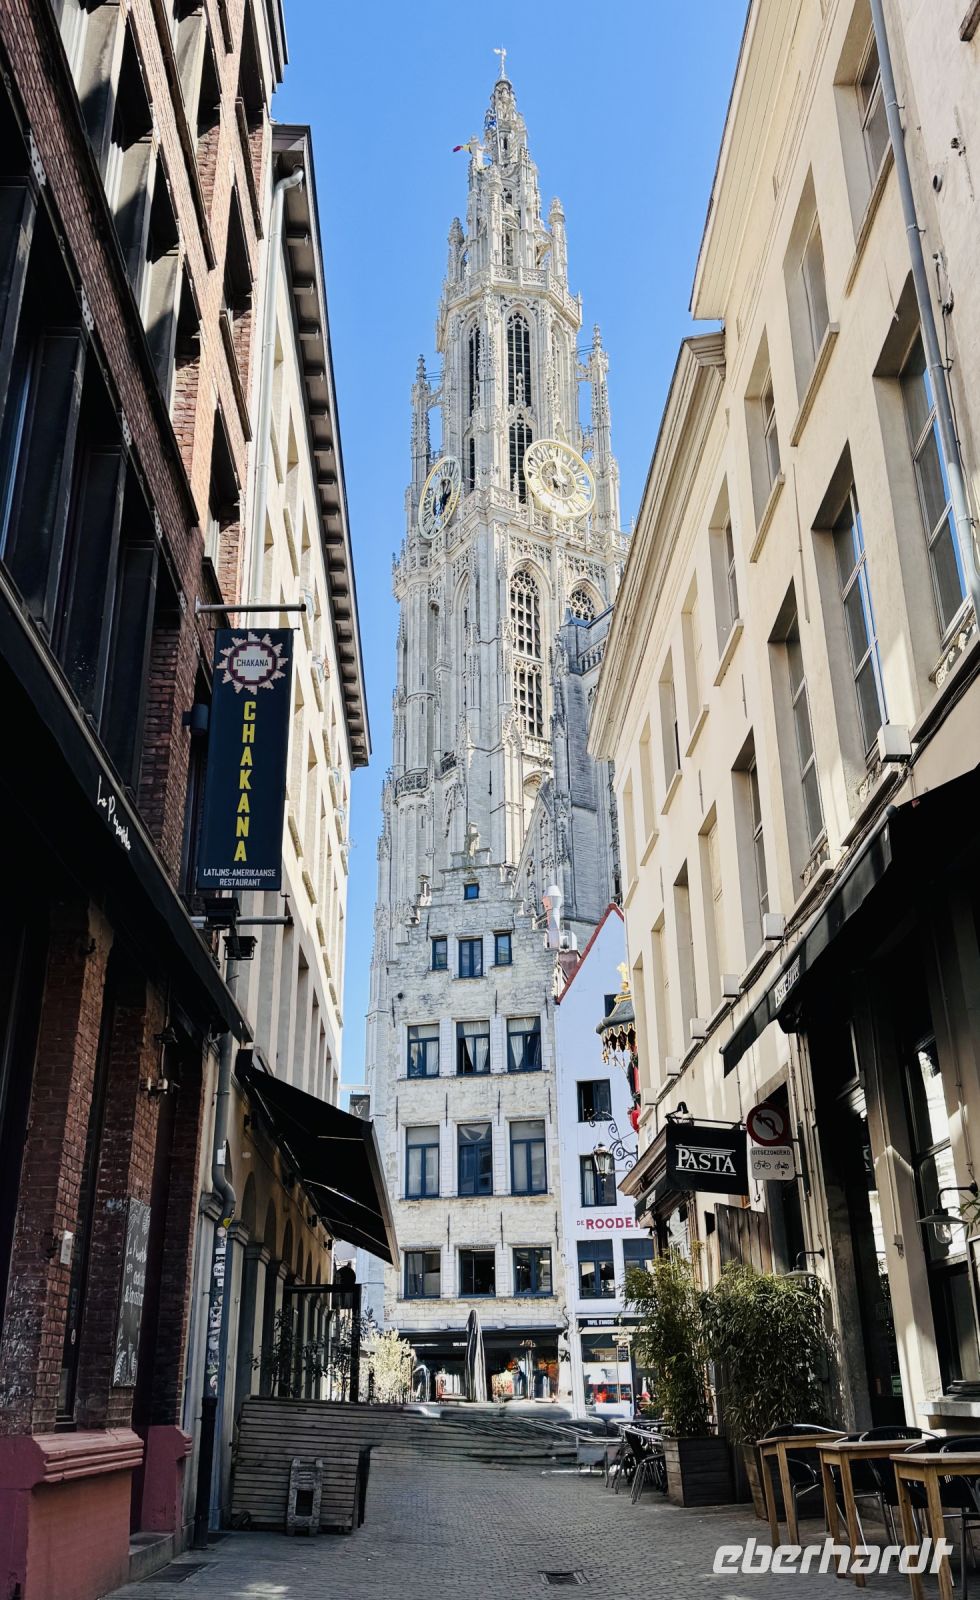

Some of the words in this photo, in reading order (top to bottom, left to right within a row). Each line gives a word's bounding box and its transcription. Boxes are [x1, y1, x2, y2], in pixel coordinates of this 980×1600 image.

[236, 658, 269, 668] CHAKANA
[234, 701, 257, 862] CHAKANA
[203, 868, 276, 877] LATIJNS-AMERIKAANSE
[219, 877, 261, 887] RESTAURANT
[675, 1148, 736, 1173] PASTA
